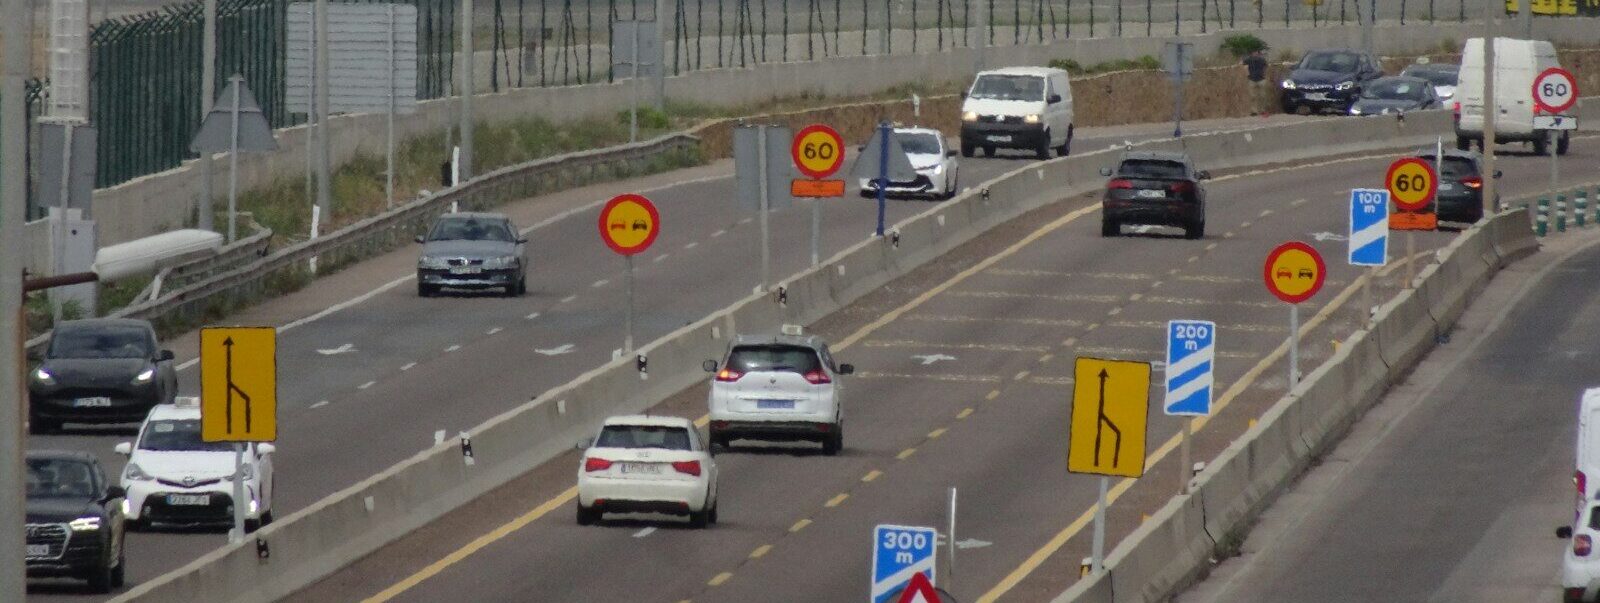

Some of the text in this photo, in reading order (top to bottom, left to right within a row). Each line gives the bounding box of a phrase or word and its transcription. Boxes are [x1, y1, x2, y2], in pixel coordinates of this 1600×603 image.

[1543, 83, 1567, 97] 60
[804, 142, 833, 160] 60
[1396, 174, 1425, 192] 60
[1359, 193, 1382, 204] 100
[1364, 205, 1375, 213] m
[1176, 325, 1208, 339] 200
[1184, 340, 1198, 350] m
[883, 532, 927, 550] 300
[895, 552, 913, 564] m
